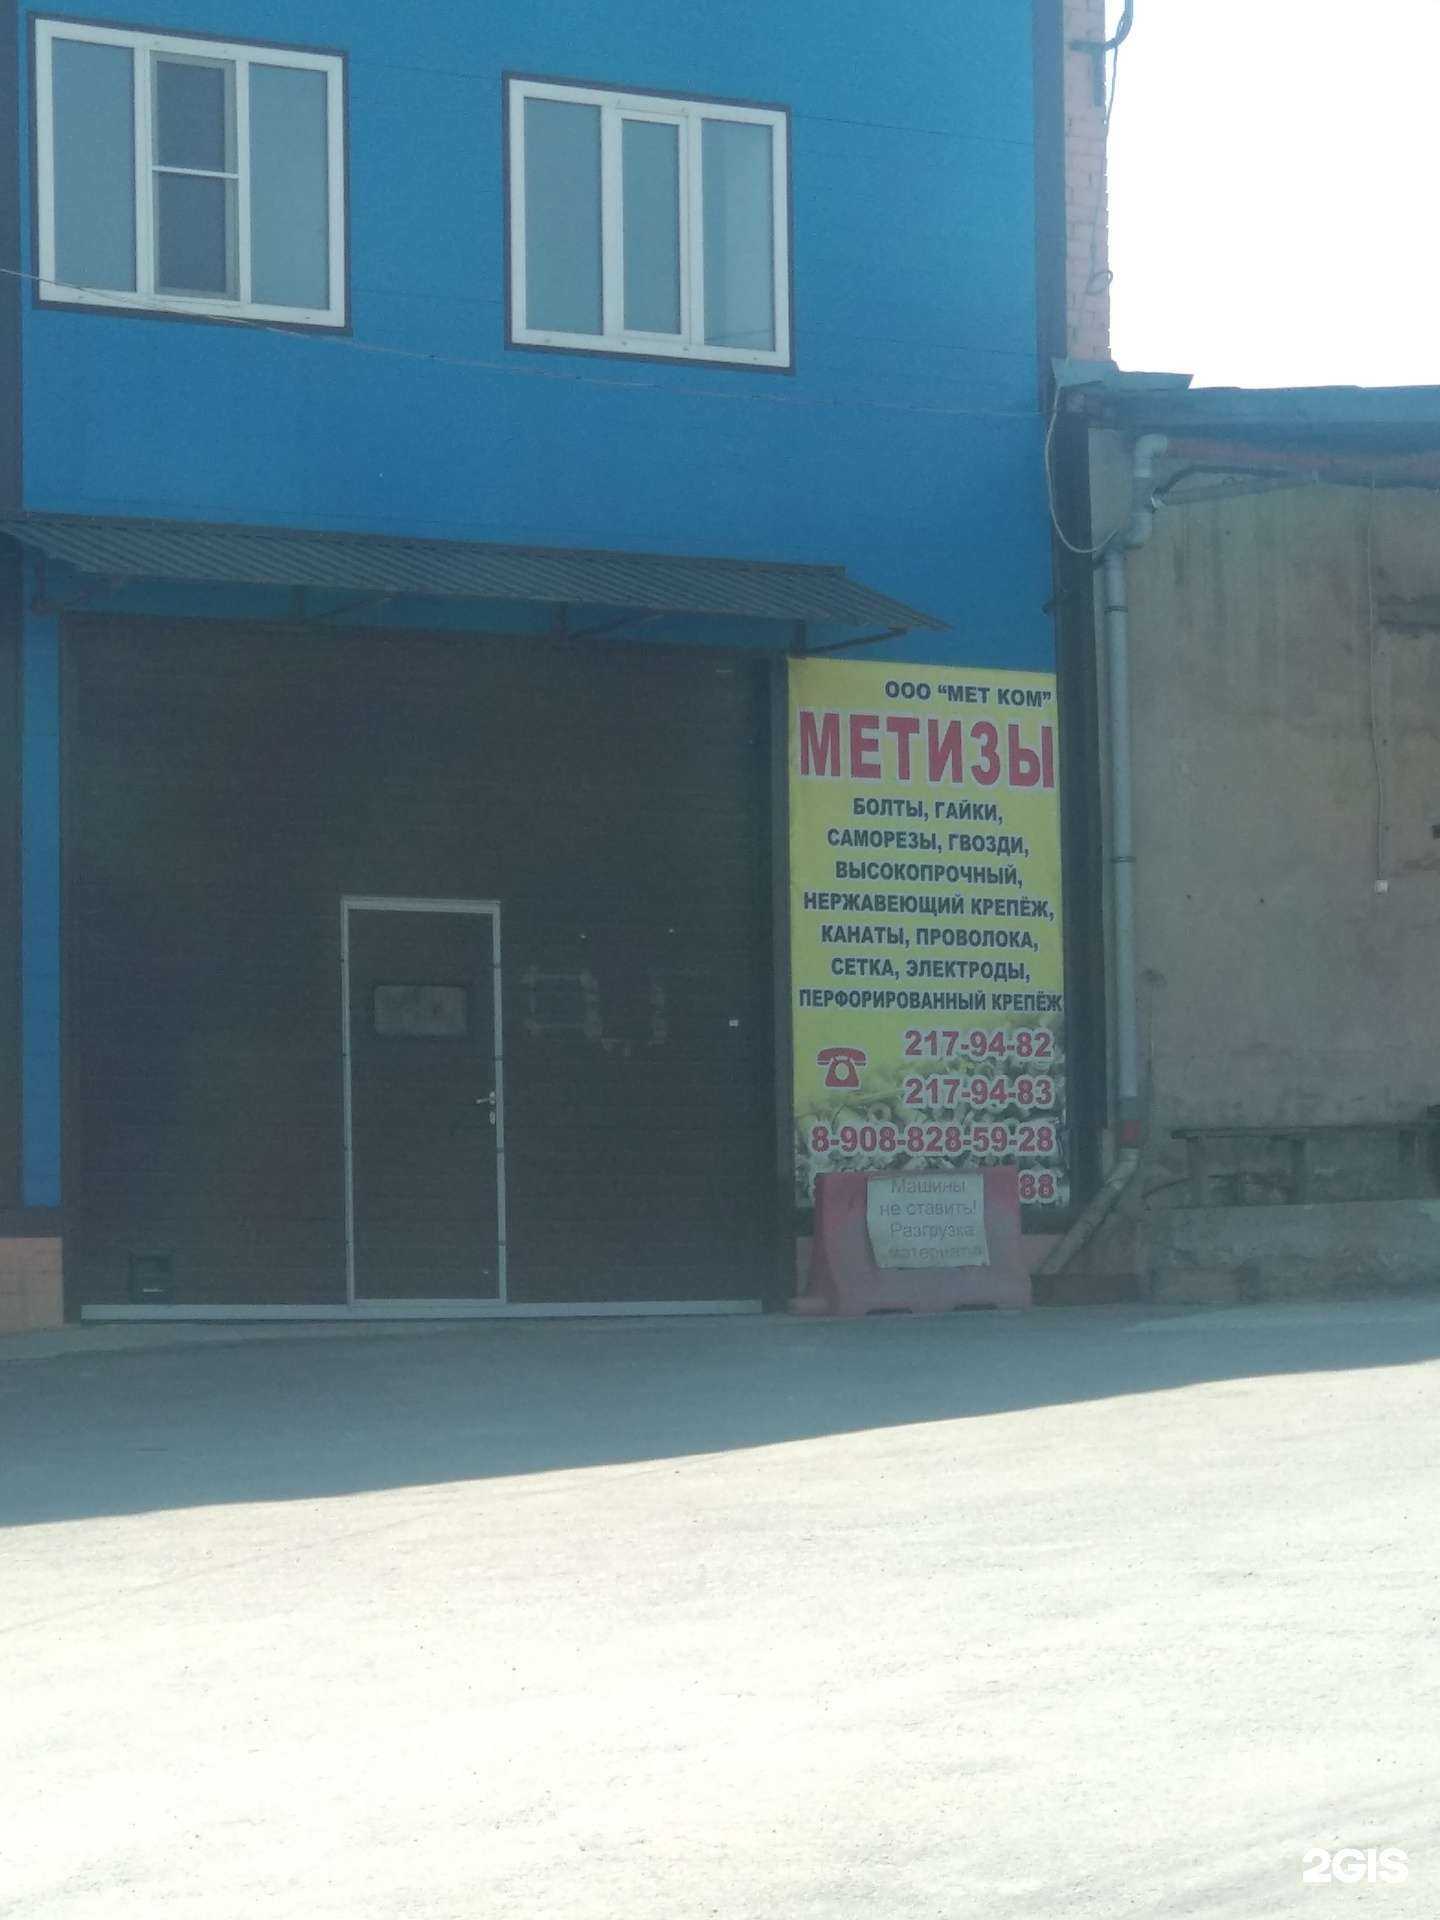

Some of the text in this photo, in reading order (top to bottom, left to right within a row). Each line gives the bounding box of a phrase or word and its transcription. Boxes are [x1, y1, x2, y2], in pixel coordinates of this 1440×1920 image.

[885, 681, 931, 699] ООО
[799, 711, 1055, 788] МЕТИЗЫ
[853, 797, 1003, 824] БОЛТЫ, ГАЙКИ,
[827, 828, 1029, 857] САМОРЕЗЫ, ГВОЗДИ,
[835, 861, 1023, 888] ВЫСОКОПРОЧНЫЙ,
[803, 892, 1054, 921] НЕРЖАВЕЮЩИЙ КРЕПЁЖ,
[821, 925, 1039, 952] КАНАТЫ, ПРОВОЛОКА,
[831, 957, 1030, 983] СЕТКА, ЭЛЕКТРОДЫ,
[799, 988, 1063, 1012] ПЕРФОРИРОВАННЫЙ КРЕПЁЖ
[904, 1029, 1053, 1057] 217-94-82
[905, 1077, 1053, 1105] 217-94-83
[811, 1126, 1055, 1152] 8-908-828-59-28
[880, 1203, 900, 1216] не
